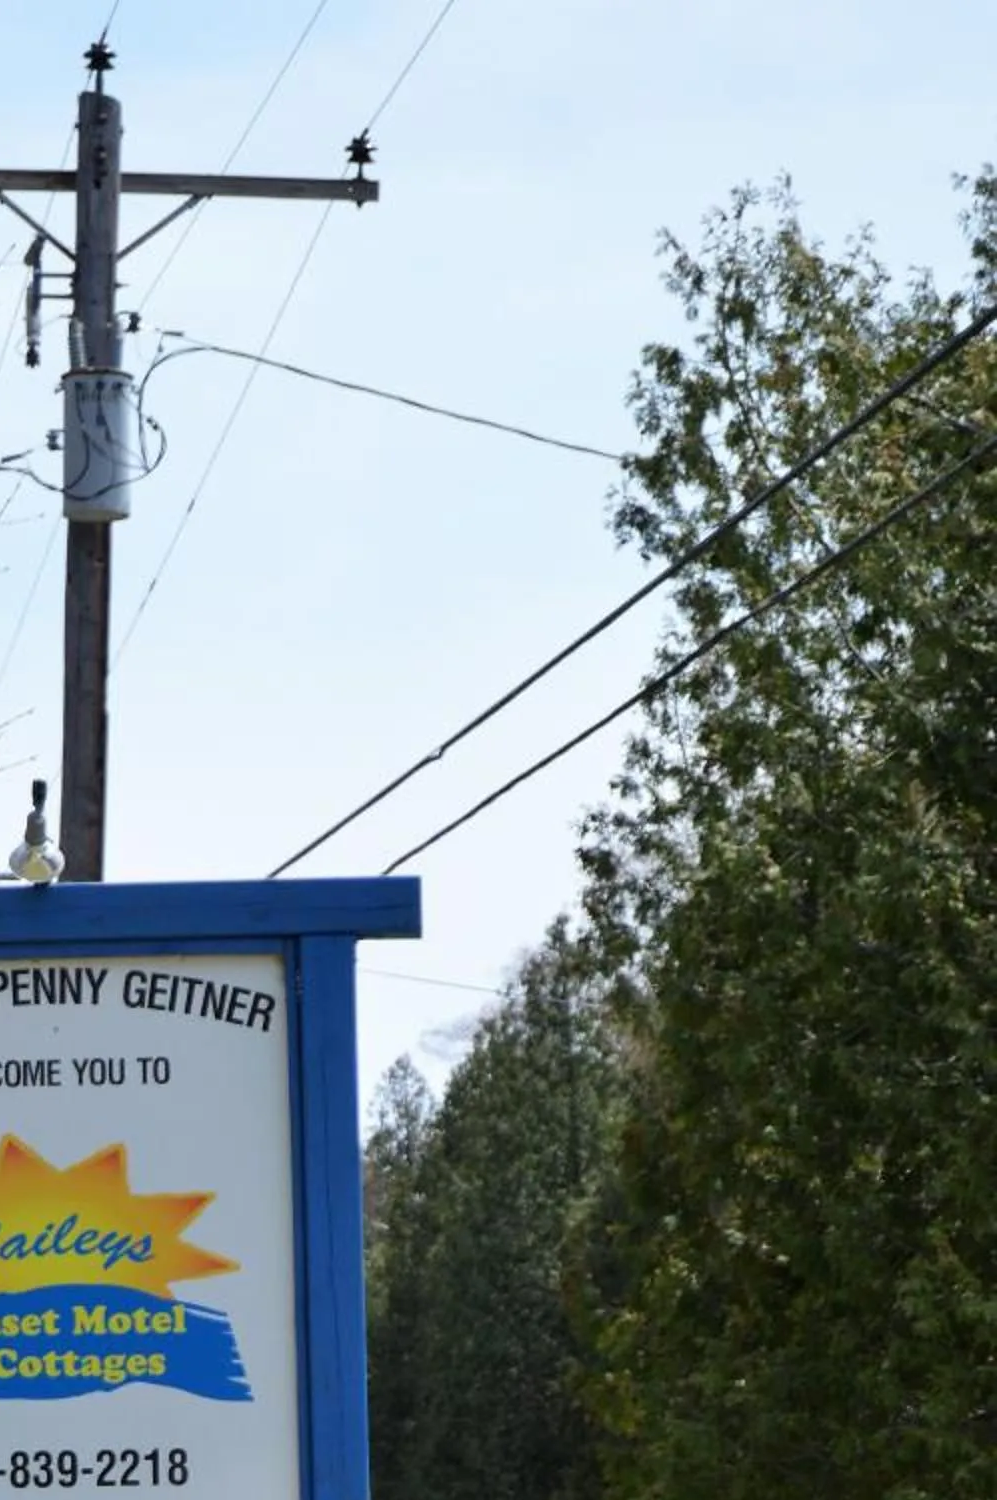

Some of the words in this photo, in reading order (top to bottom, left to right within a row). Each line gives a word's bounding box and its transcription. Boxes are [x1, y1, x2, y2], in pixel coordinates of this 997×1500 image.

[122, 970, 276, 1033] GEITNER
[72, 1058, 125, 1086] YOU
[136, 1057, 171, 1084] TO
[73, 1304, 187, 1335] Motel
